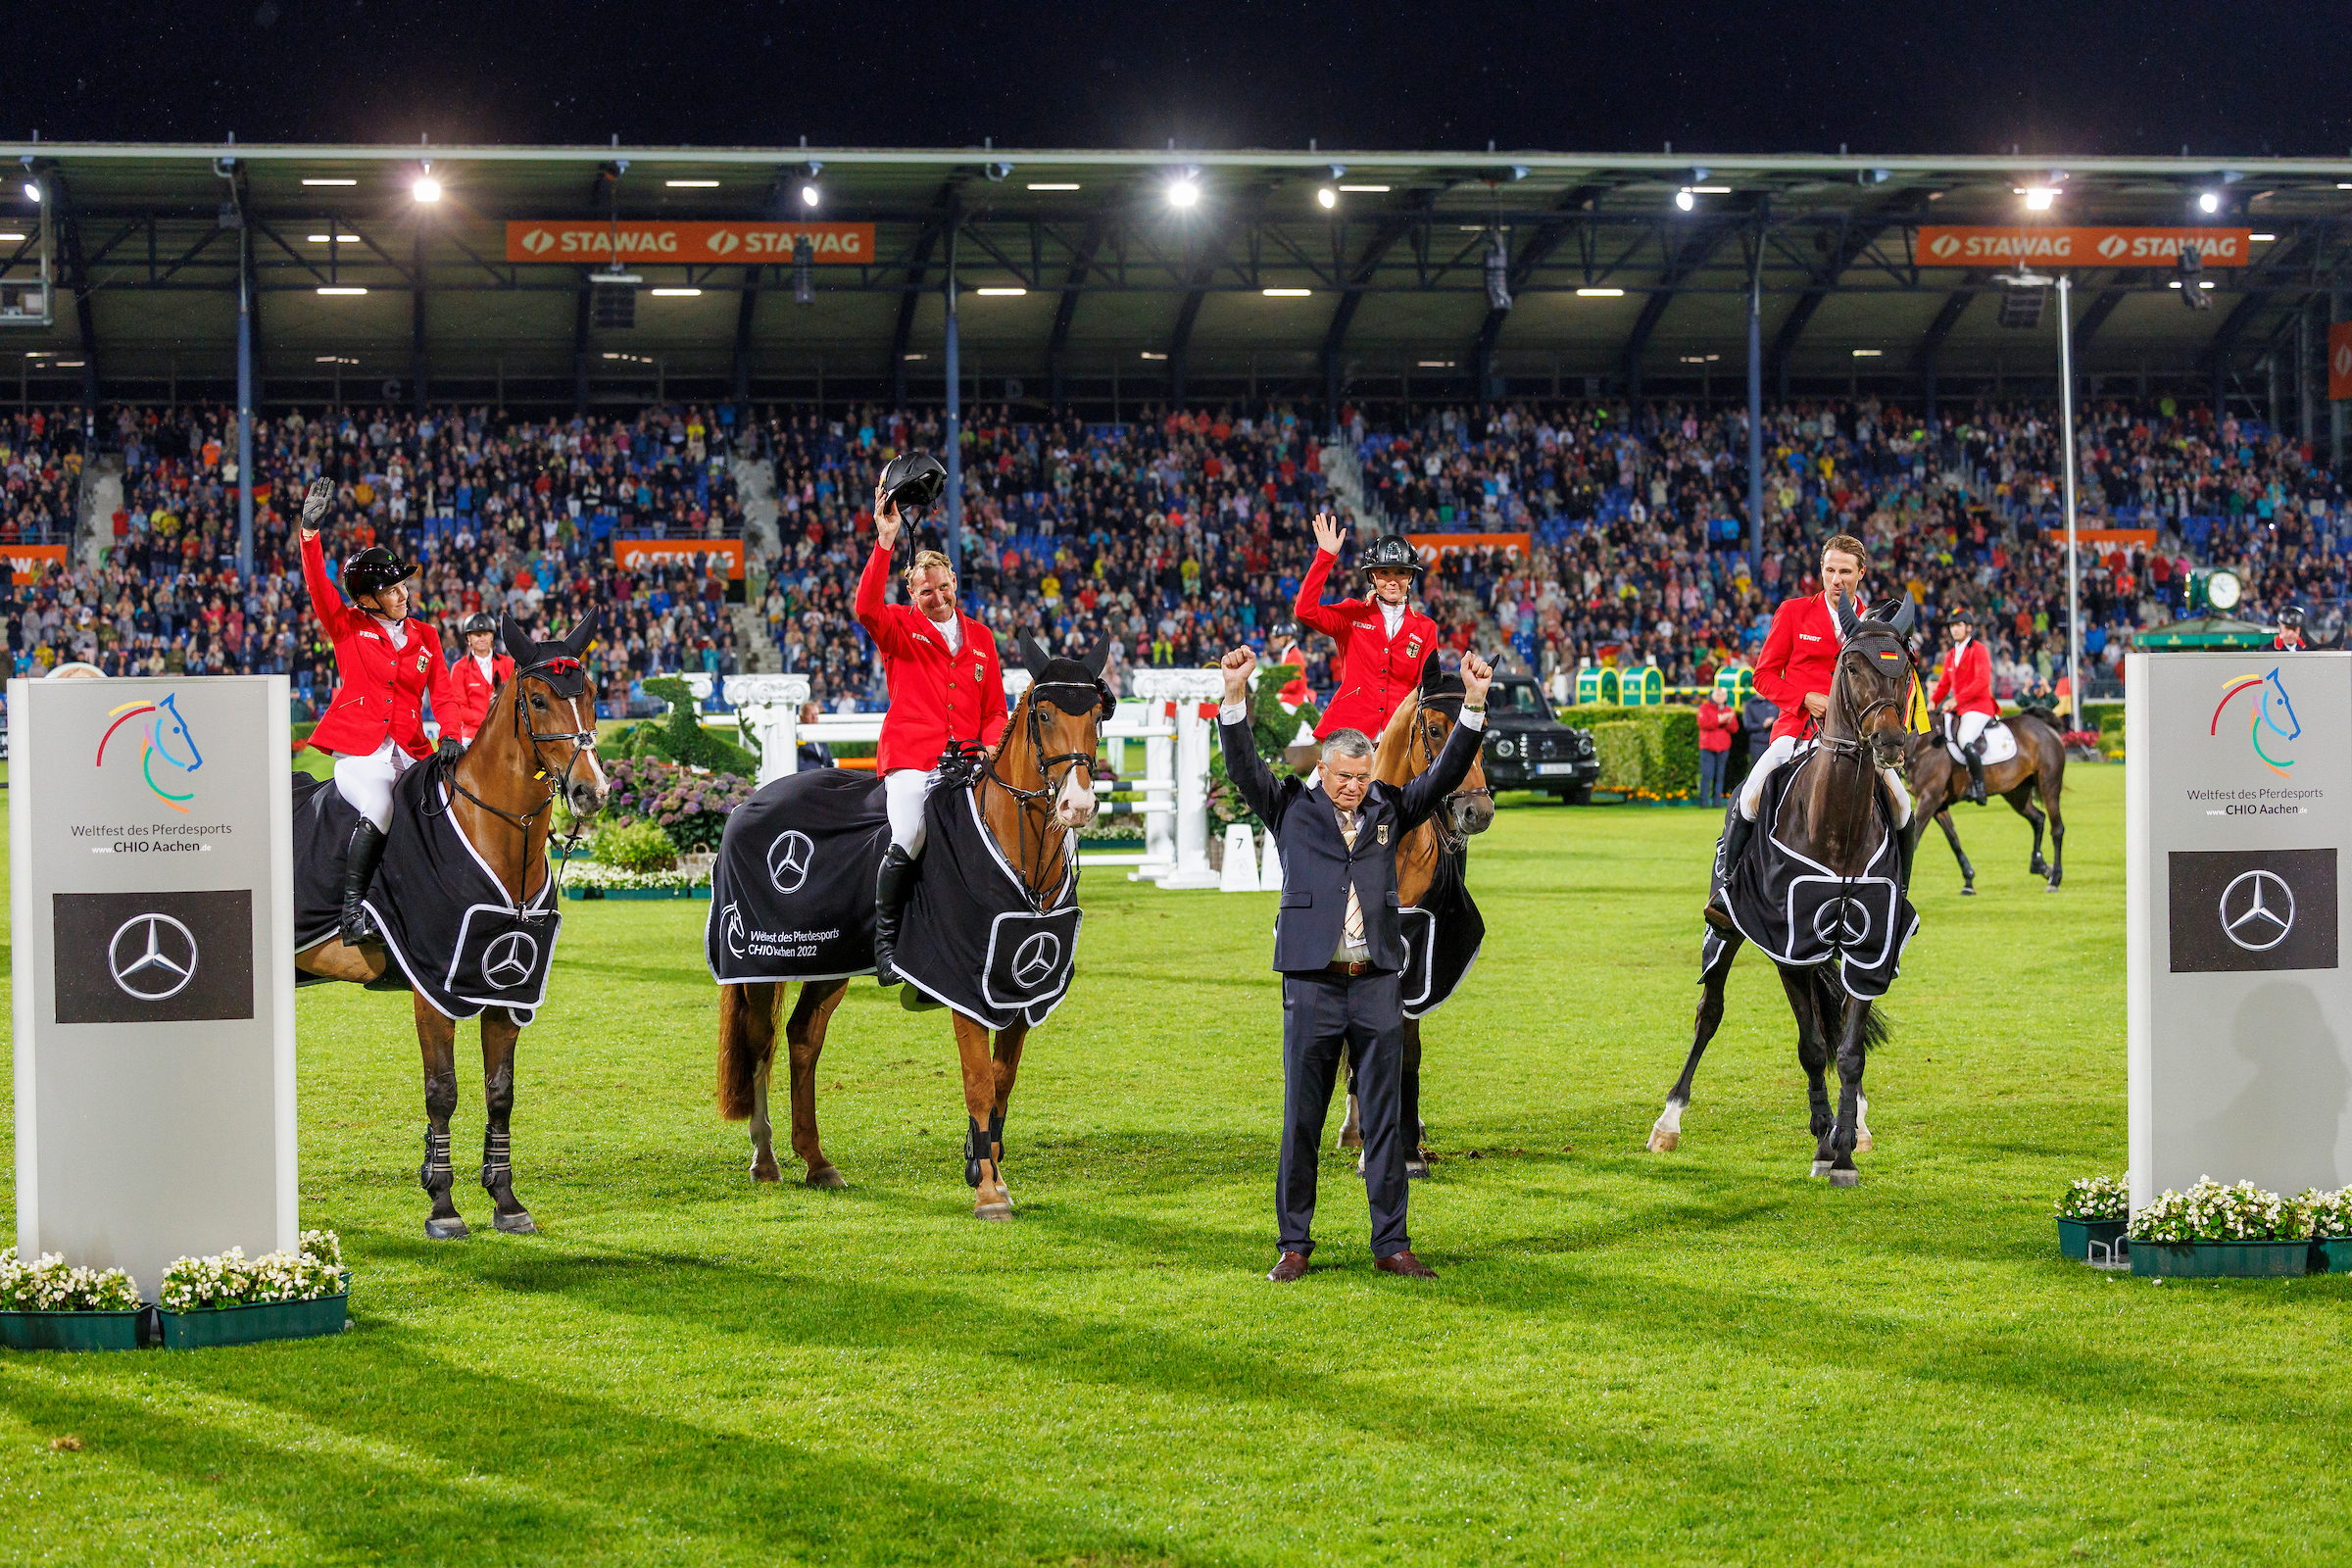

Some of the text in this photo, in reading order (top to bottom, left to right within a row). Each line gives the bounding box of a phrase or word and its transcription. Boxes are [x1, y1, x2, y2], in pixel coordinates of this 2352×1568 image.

[561, 231, 677, 253] STAWAG
[1964, 236, 2237, 258] STAWAG STAWAG
[1352, 620, 1376, 631] FENDT
[359, 630, 380, 640] FEND
[912, 632, 932, 645] FEN
[1799, 633, 1822, 643] FENDT
[2186, 788, 2324, 801] Weltfest des Pferdesports
[2206, 804, 2308, 815] www.CHIO Aachen.de
[71, 823, 232, 837] Weltfest des Pferdesports
[91, 840, 212, 854] www.CHIO Aachen.de
[1236, 838, 1244, 850] 7
[777, 931, 793, 943] des
[796, 945, 817, 957] 2022
